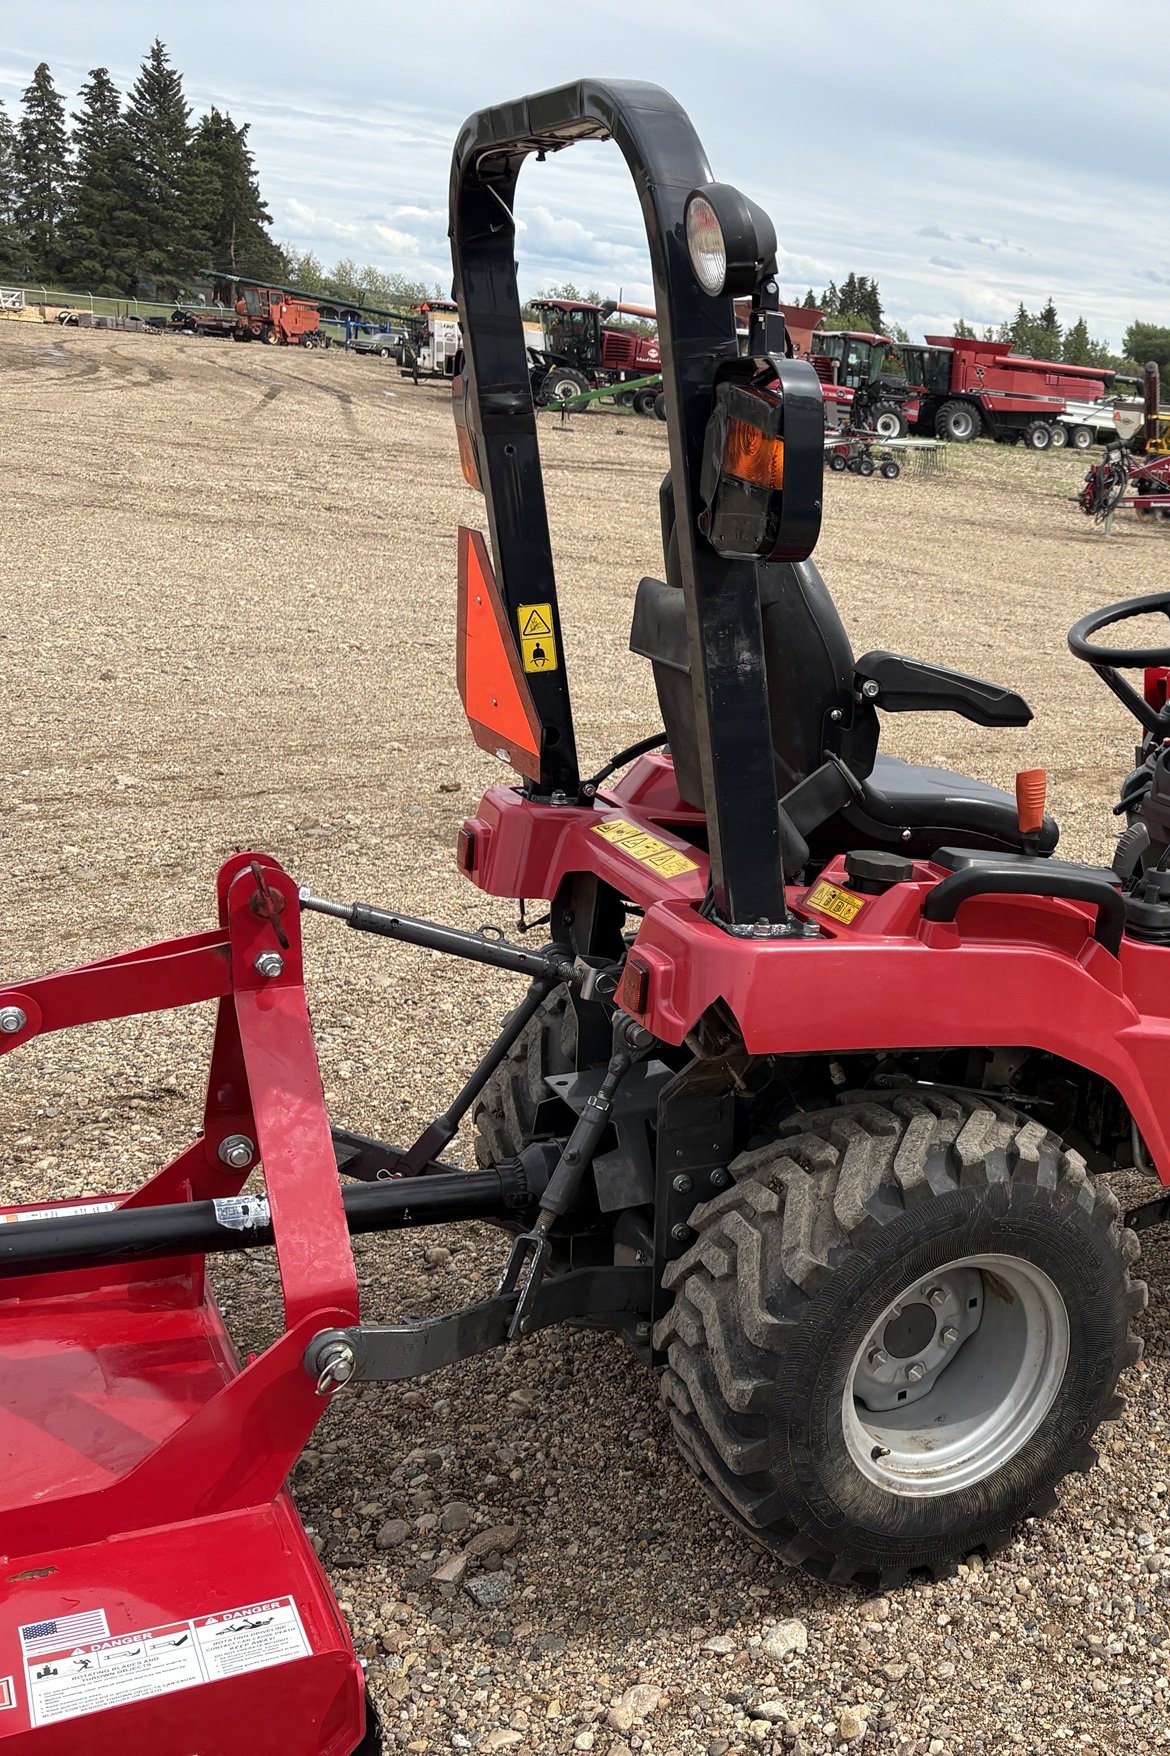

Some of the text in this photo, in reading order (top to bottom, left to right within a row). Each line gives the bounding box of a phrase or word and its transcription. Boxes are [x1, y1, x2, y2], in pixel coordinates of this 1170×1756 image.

[222, 1601, 281, 1621] DANGER
[90, 1632, 153, 1652] DANGER
[213, 1625, 287, 1646] ROTATING DRIVELINE
[71, 1669, 110, 1681] ROTATING
[111, 1661, 142, 1672] BLADES
[82, 1663, 152, 1683] THROWN OBJECTS
